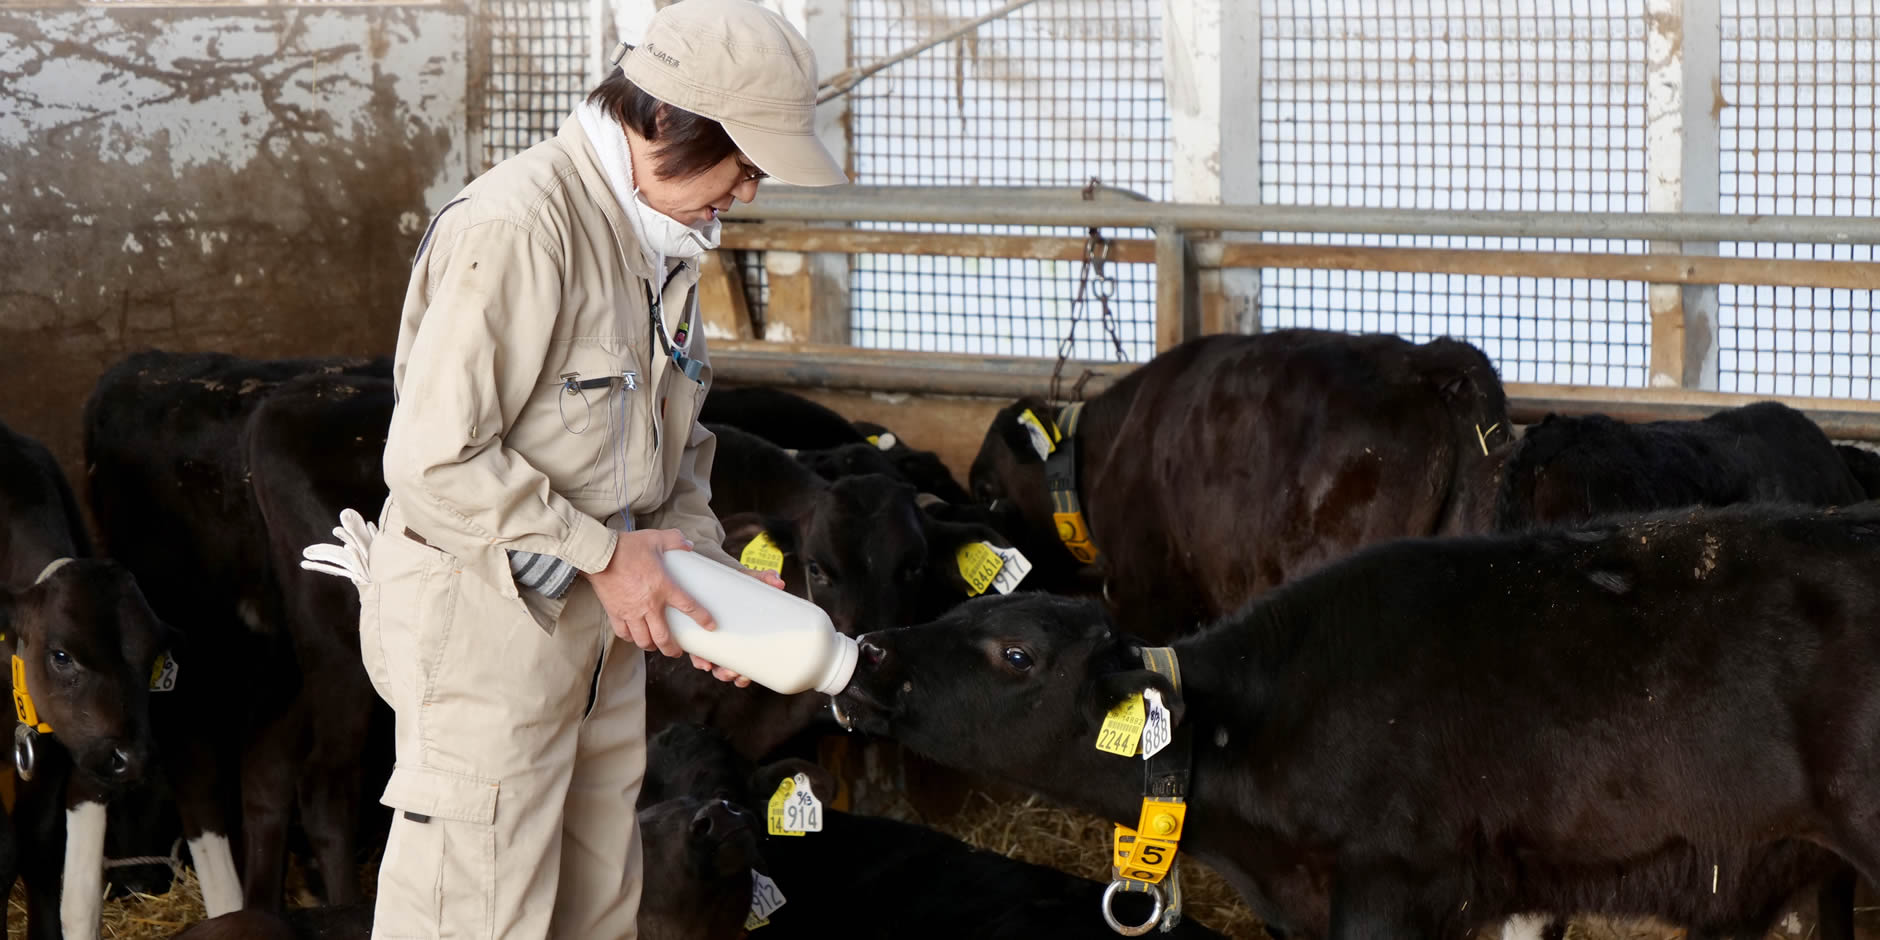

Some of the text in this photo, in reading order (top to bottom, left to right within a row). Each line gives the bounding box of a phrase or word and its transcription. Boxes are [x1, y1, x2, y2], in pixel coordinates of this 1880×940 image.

[996, 554, 1024, 591] 917
[17, 696, 26, 719] 8
[1098, 729, 1130, 752] 2244
[1145, 719, 1168, 755] 888
[788, 805, 817, 829] 914
[1141, 845, 1166, 865] 5
